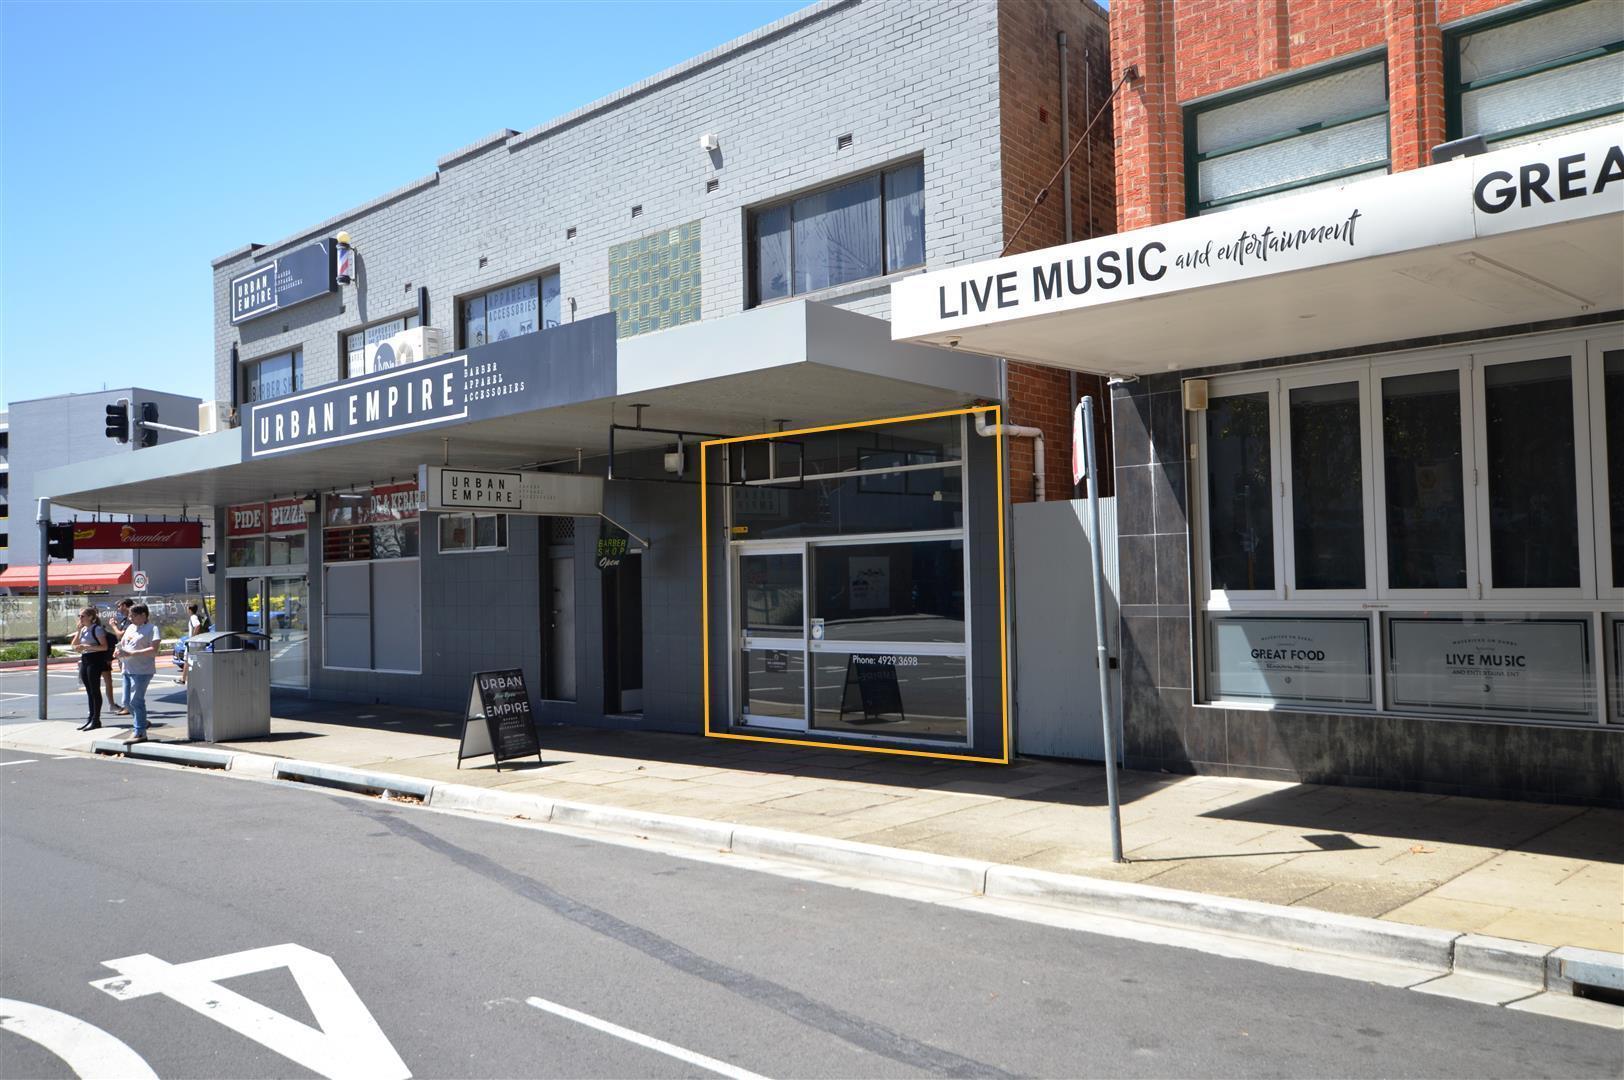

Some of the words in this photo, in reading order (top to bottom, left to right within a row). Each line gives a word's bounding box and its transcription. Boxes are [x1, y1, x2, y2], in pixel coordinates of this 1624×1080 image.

[1474, 145, 1624, 214] GREA
[938, 270, 1019, 319] LIVE
[1032, 241, 1168, 302] MUSIC
[1175, 240, 1211, 269] and
[1217, 209, 1363, 266] entertainment
[238, 275, 267, 298] URBAN
[238, 288, 272, 312] EMPIRE
[489, 299, 536, 321] ACCESSORIES
[464, 361, 497, 378] BARBER
[464, 373, 503, 390] APPAREL
[464, 381, 525, 403] ACCESSORIES
[260, 402, 334, 445] URBAN
[349, 373, 454, 425] EMPIRE
[452, 476, 505, 490] URBAN
[452, 489, 513, 503] EMPIRE
[234, 510, 261, 529] PIDE
[271, 504, 307, 526] PIZZA
[598, 538, 626, 547] BARBER
[598, 546, 625, 557] SHOP
[599, 556, 620, 569] Open
[852, 655, 876, 665] Phone:
[877, 656, 897, 665] 4929
[898, 656, 918, 666] 3698
[1251, 649, 1287, 660] GREAT
[1291, 650, 1325, 661] FOOD
[1445, 653, 1475, 666] LIVE
[1480, 654, 1526, 667] MUSIC
[480, 676, 523, 690] URBAN
[486, 701, 531, 717] EMPIRE
